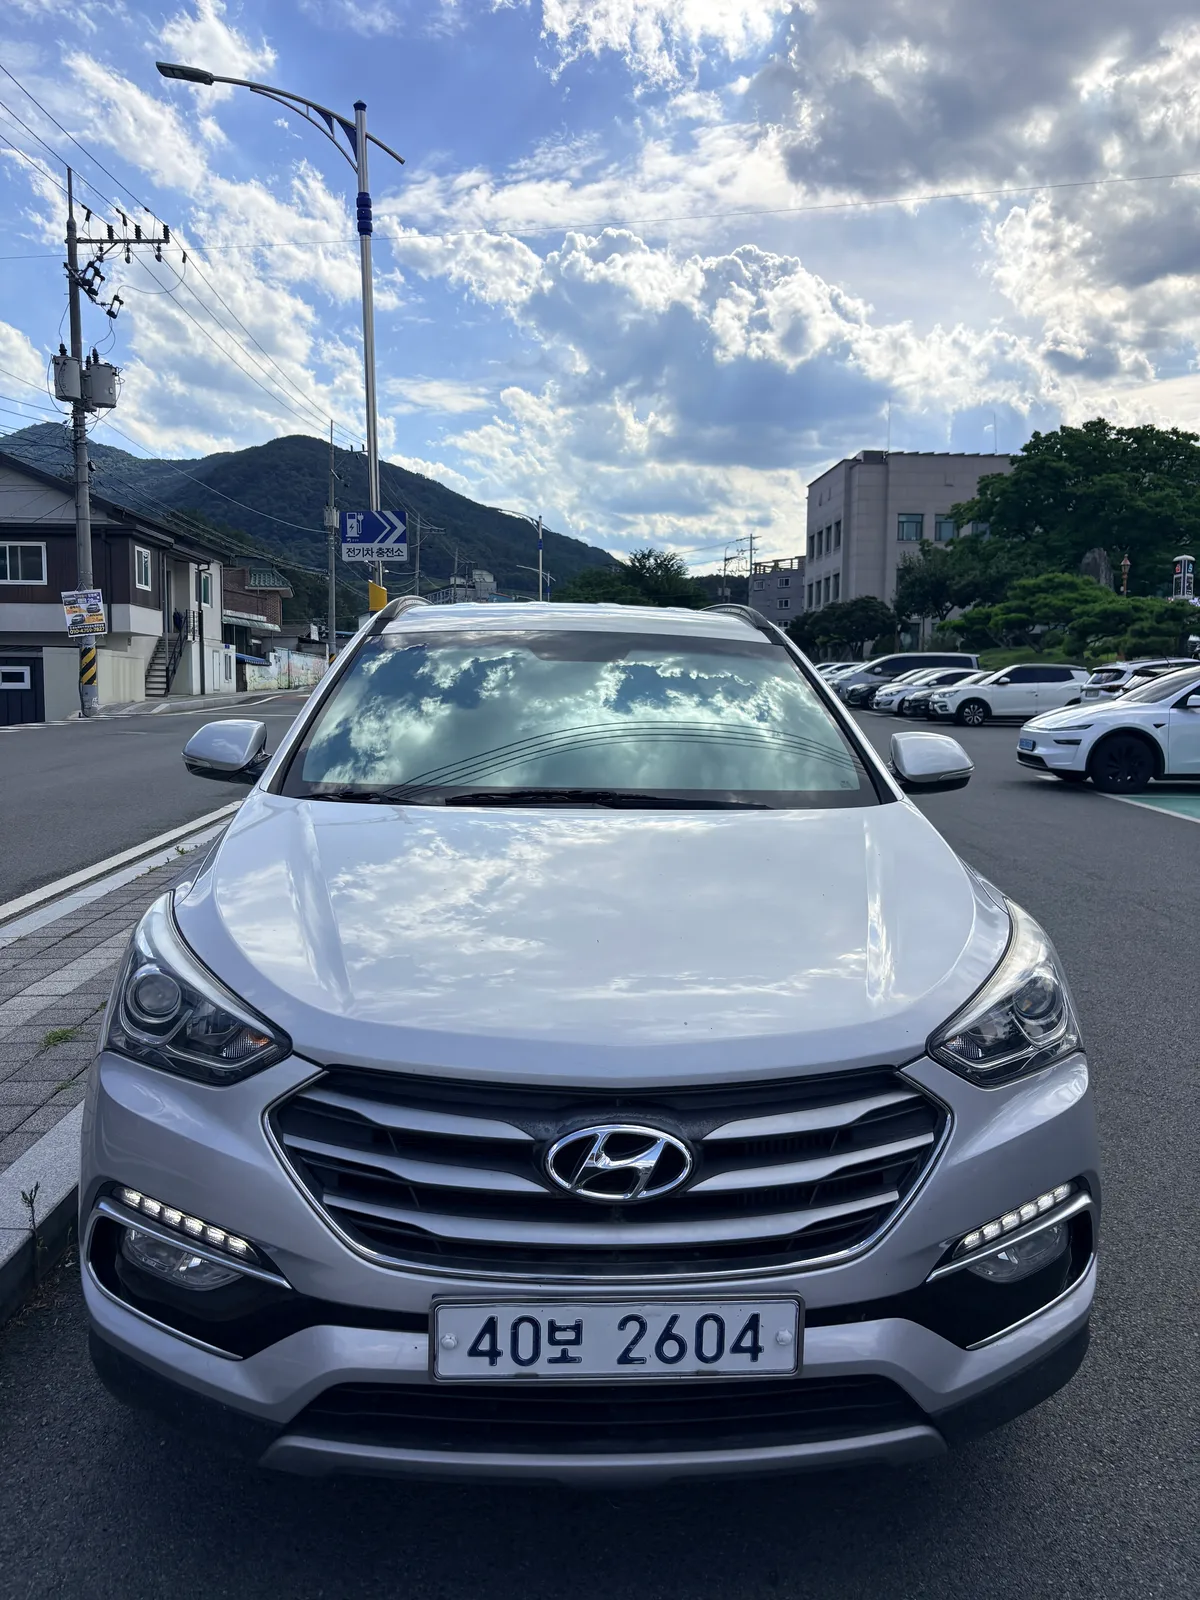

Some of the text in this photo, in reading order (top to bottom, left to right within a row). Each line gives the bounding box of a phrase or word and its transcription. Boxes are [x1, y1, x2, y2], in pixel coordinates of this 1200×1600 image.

[346, 547, 404, 558] 전기차 충전소
[467, 1312, 765, 1367] 40보 2604
